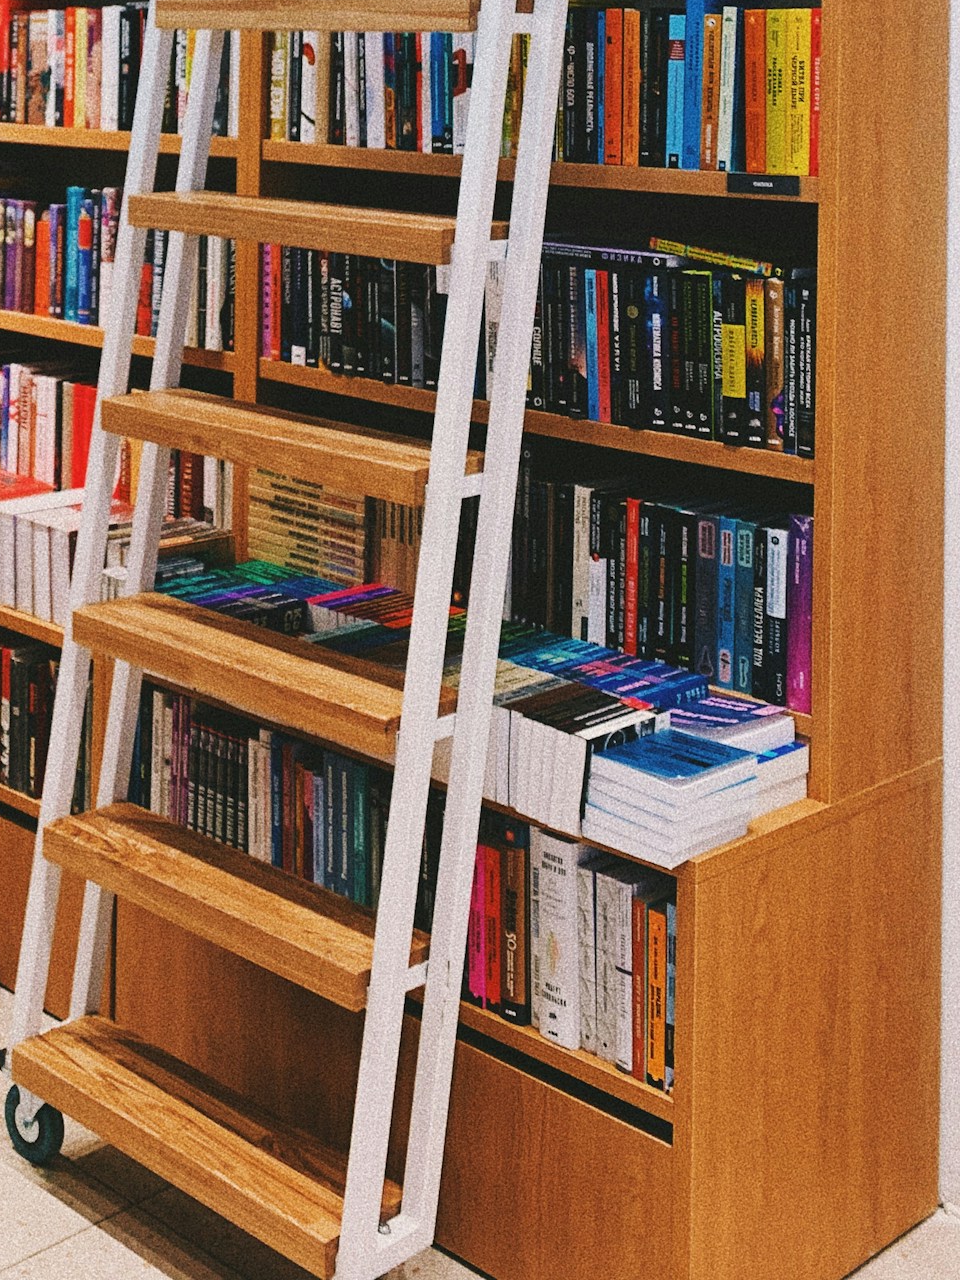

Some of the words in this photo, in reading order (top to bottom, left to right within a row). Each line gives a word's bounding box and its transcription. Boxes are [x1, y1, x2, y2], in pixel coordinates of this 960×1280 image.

[566, 88, 575, 107] БОГА
[585, 90, 594, 132] РЕАЛЬНОСТЬ
[602, 252, 643, 265] ФИЗИКА
[330, 277, 342, 335] АСТРОНАВТ
[532, 326, 543, 366] СОЛНЦЕ
[652, 313, 662, 357] МАТЕМАТИКА
[713, 310, 723, 379] АСТРОФИЗИКА
[789, 345, 795, 353] ЛИ
[653, 358, 662, 390] КОСМОСА
[754, 586, 764, 645] БЕСТСЕЛЛЕРА
[753, 649, 763, 667] КОД
